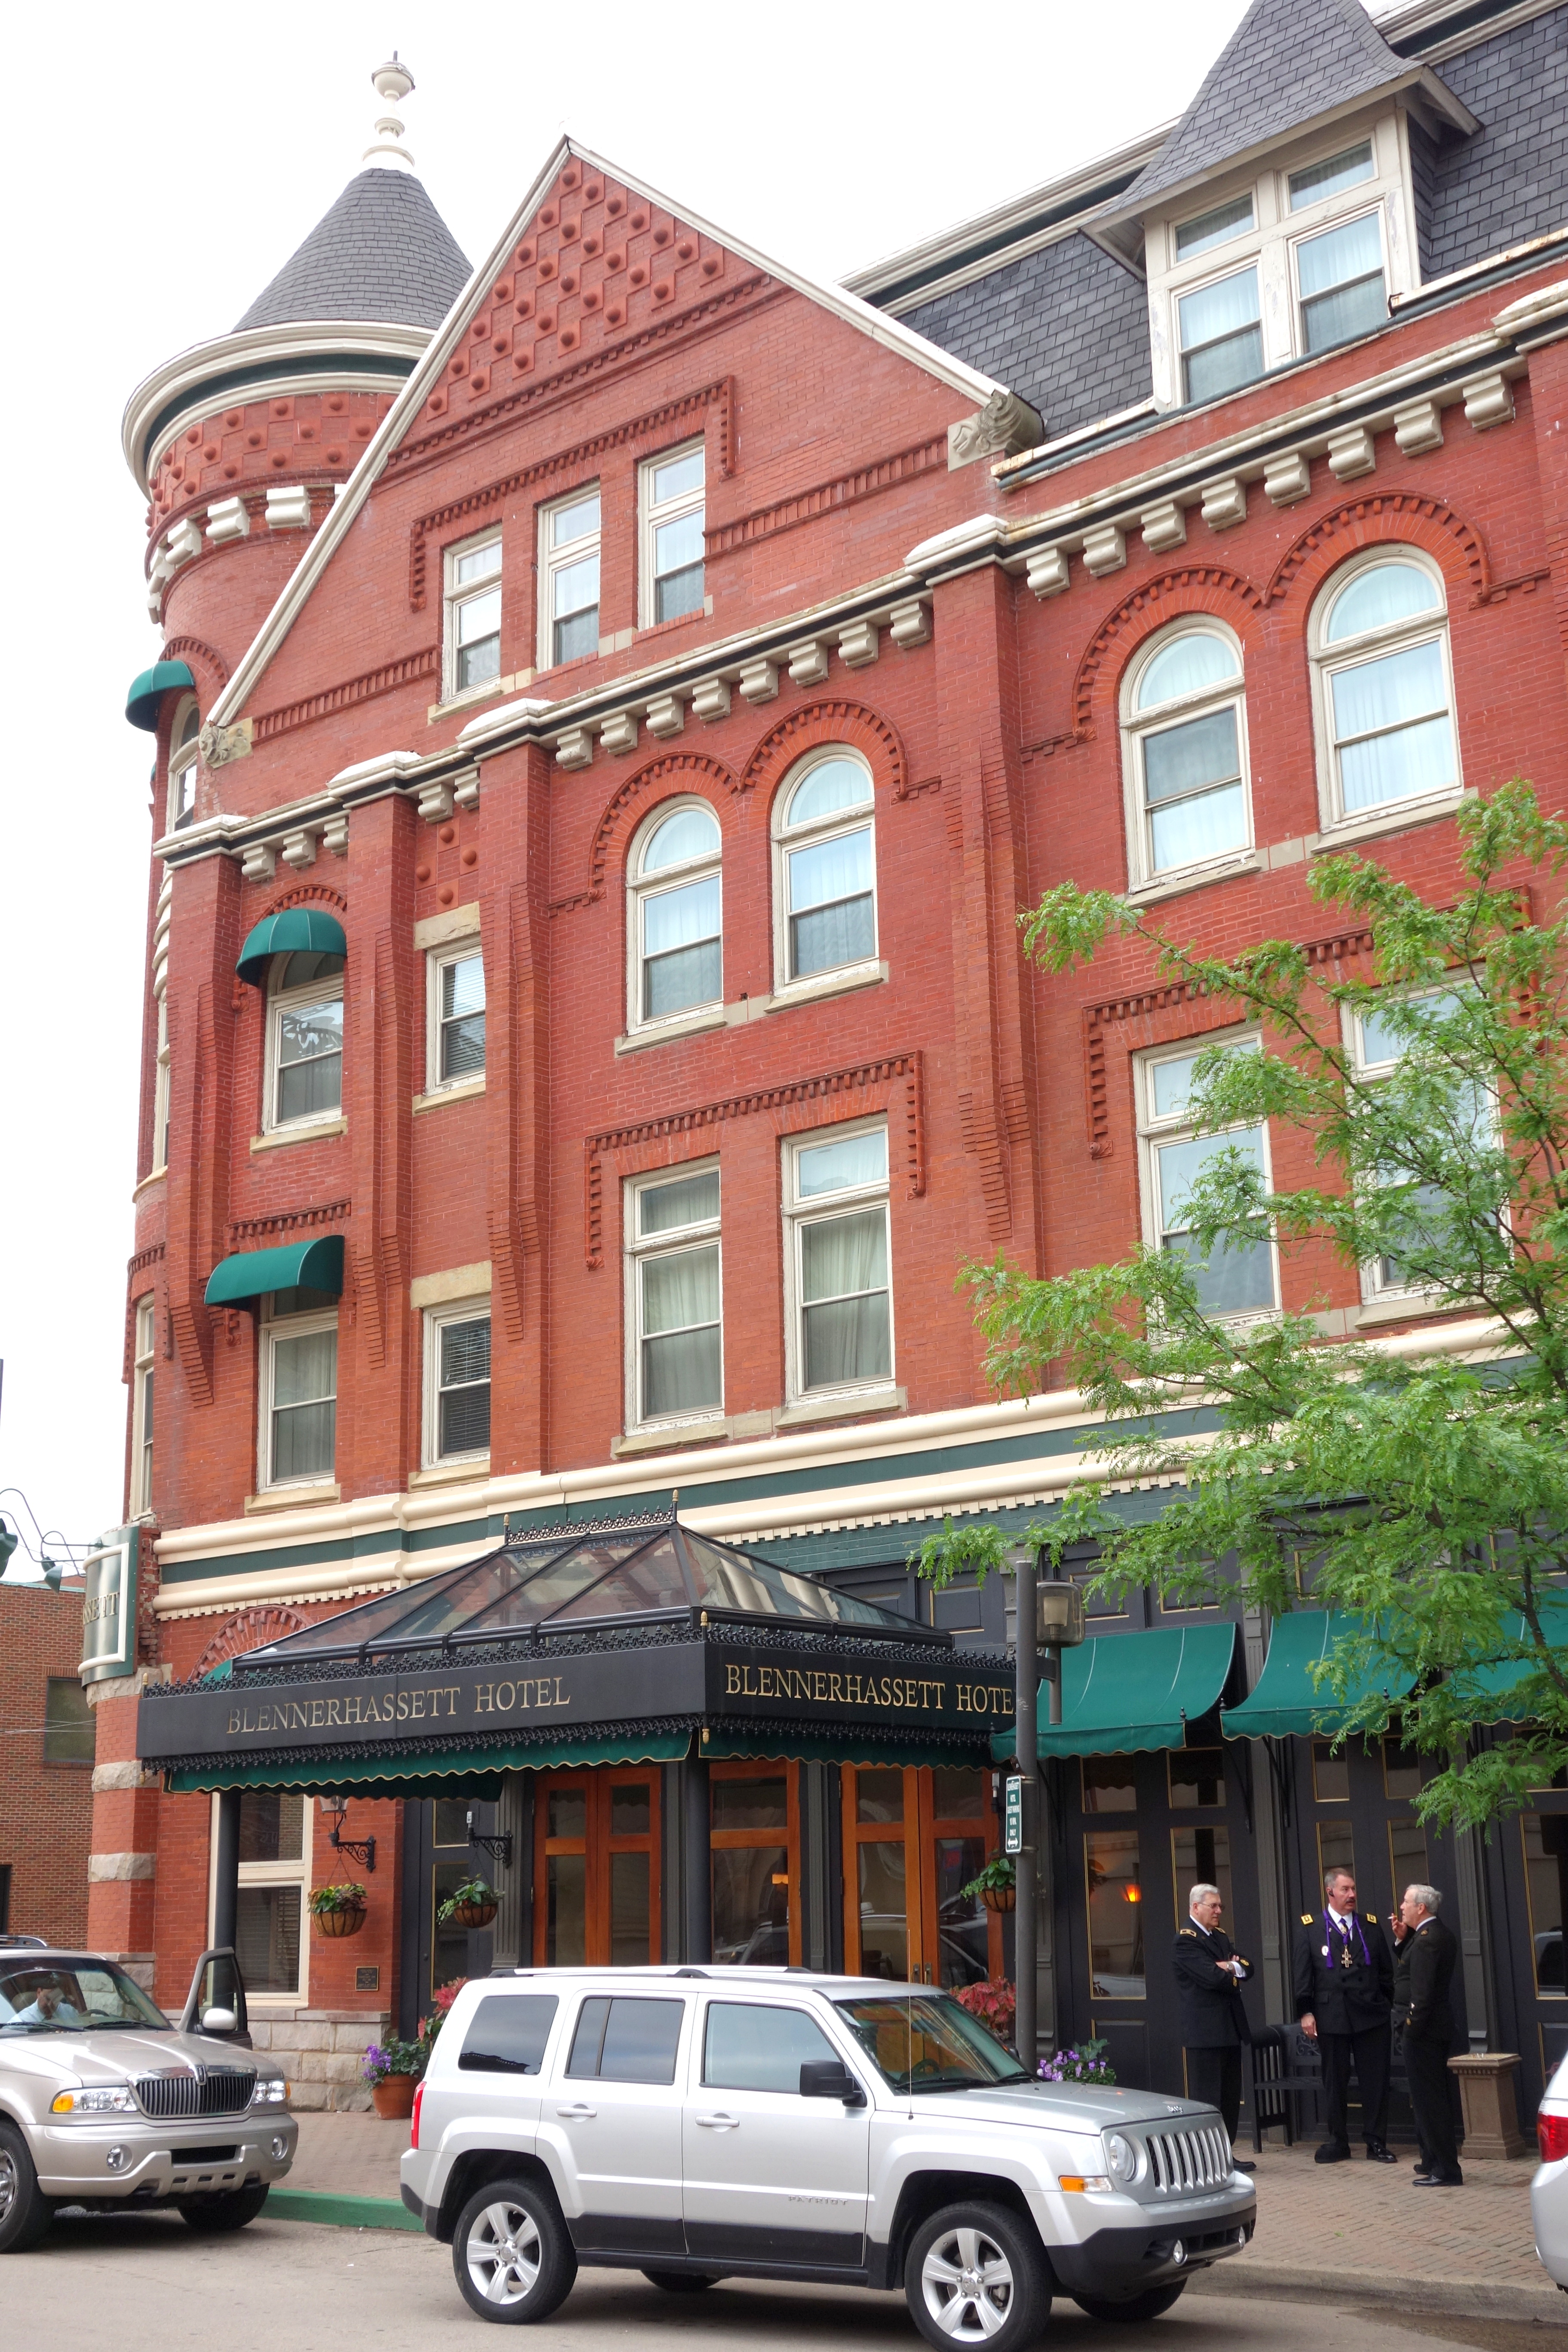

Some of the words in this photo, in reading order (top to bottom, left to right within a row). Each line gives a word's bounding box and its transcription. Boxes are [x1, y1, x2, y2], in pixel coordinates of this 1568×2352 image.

[226, 1687, 460, 1734] BLENNERHASSETT
[474, 1677, 570, 1712] HOTEL
[725, 1664, 946, 1709] BLENNERHASSETT
[956, 1684, 1017, 1715] HOTE
[788, 2195, 848, 2205] PATRIOT
